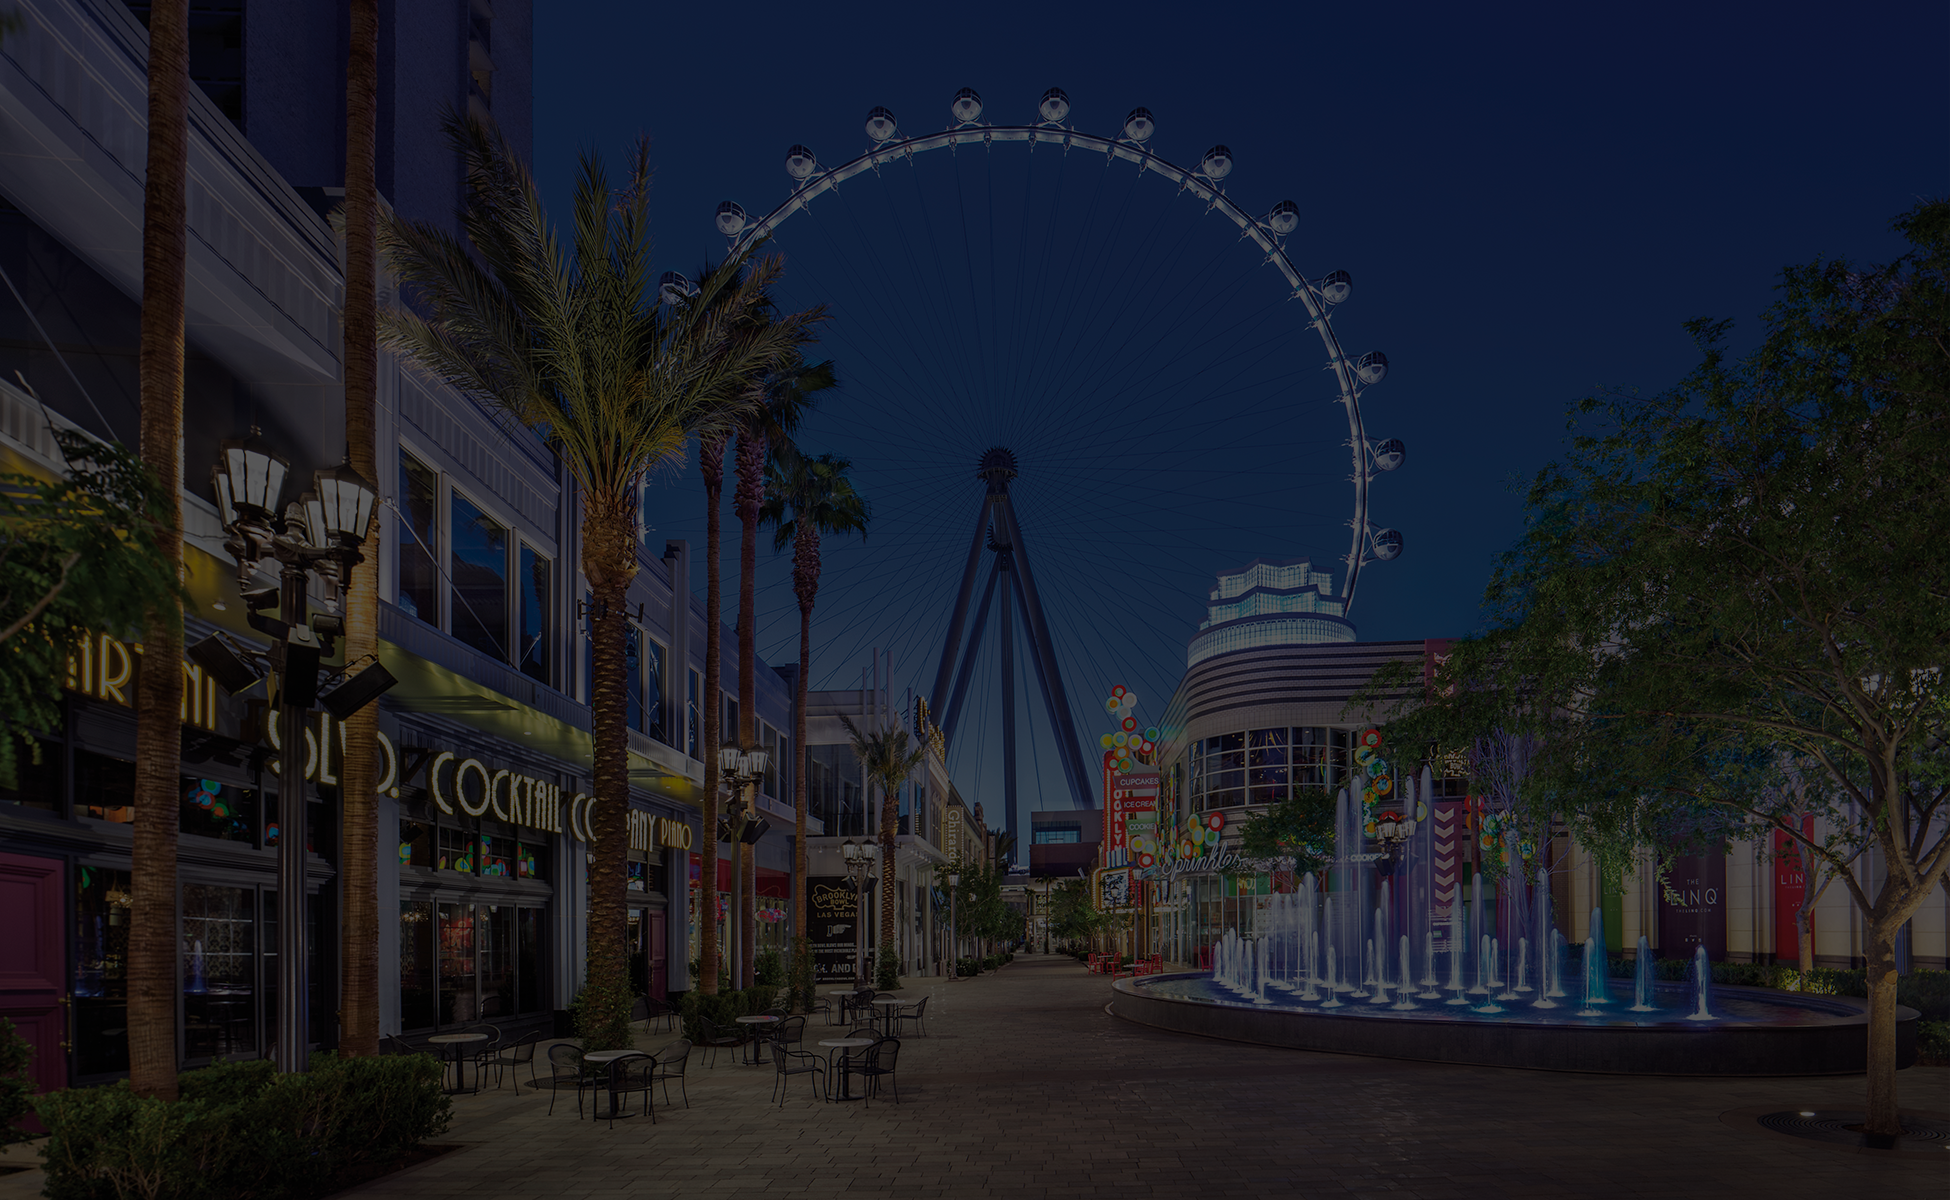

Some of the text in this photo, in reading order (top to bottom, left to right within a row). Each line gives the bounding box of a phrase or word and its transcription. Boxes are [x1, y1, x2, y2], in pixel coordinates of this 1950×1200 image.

[1119, 777, 1160, 787] CUPCAKES
[431, 750, 563, 834] COCKTAIL
[571, 792, 657, 853] COANY
[1123, 801, 1135, 809] ICE
[1128, 822, 1156, 832] COOKIE
[661, 816, 693, 851] PIANO
[1161, 840, 1249, 882] Sprinkles
[1686, 878, 1700, 886] THE
[1780, 873, 1804, 885] LIN
[816, 911, 832, 919] LAS
[830, 963, 852, 974] AND
